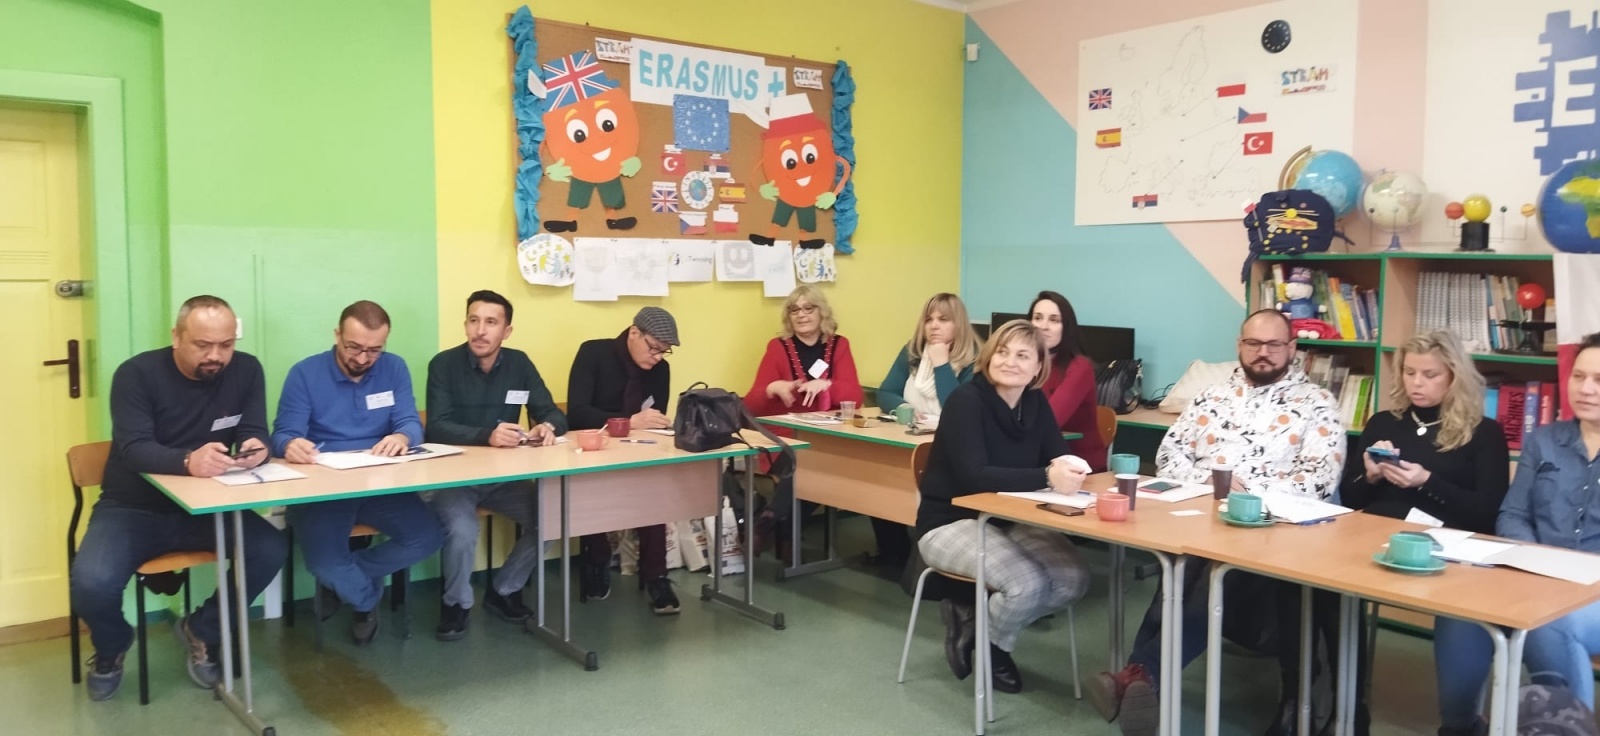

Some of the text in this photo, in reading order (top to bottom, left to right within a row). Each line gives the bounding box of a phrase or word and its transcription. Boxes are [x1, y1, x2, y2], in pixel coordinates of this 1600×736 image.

[639, 49, 784, 100] ERASMUS +
[1281, 66, 1329, 86] STEAM
[1504, 391, 1524, 443] MACHINES
